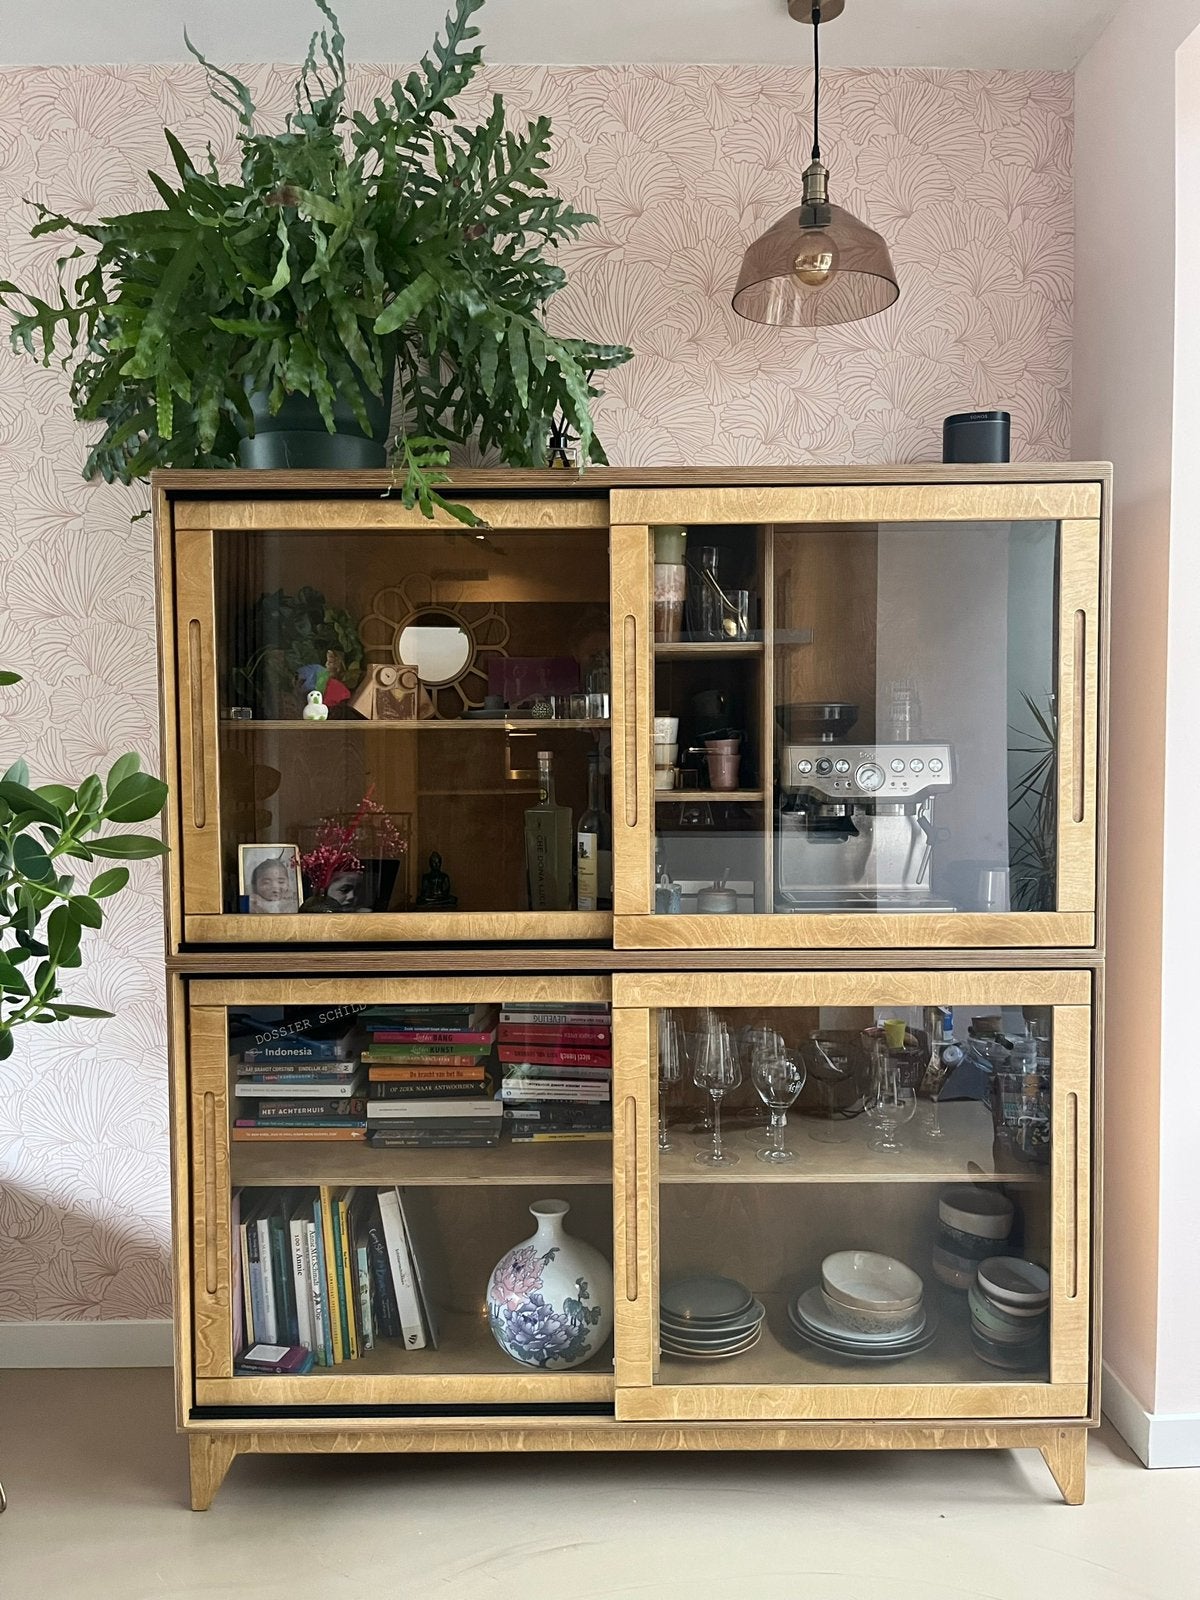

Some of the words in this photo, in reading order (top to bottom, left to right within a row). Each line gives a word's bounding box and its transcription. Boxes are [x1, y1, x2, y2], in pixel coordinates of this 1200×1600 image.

[255, 1019, 313, 1045] DOSSIER
[265, 1047, 313, 1056] Indonesia
[278, 1106, 325, 1115] ACHTERHUIS
[296, 1253, 304, 1276] Annie
